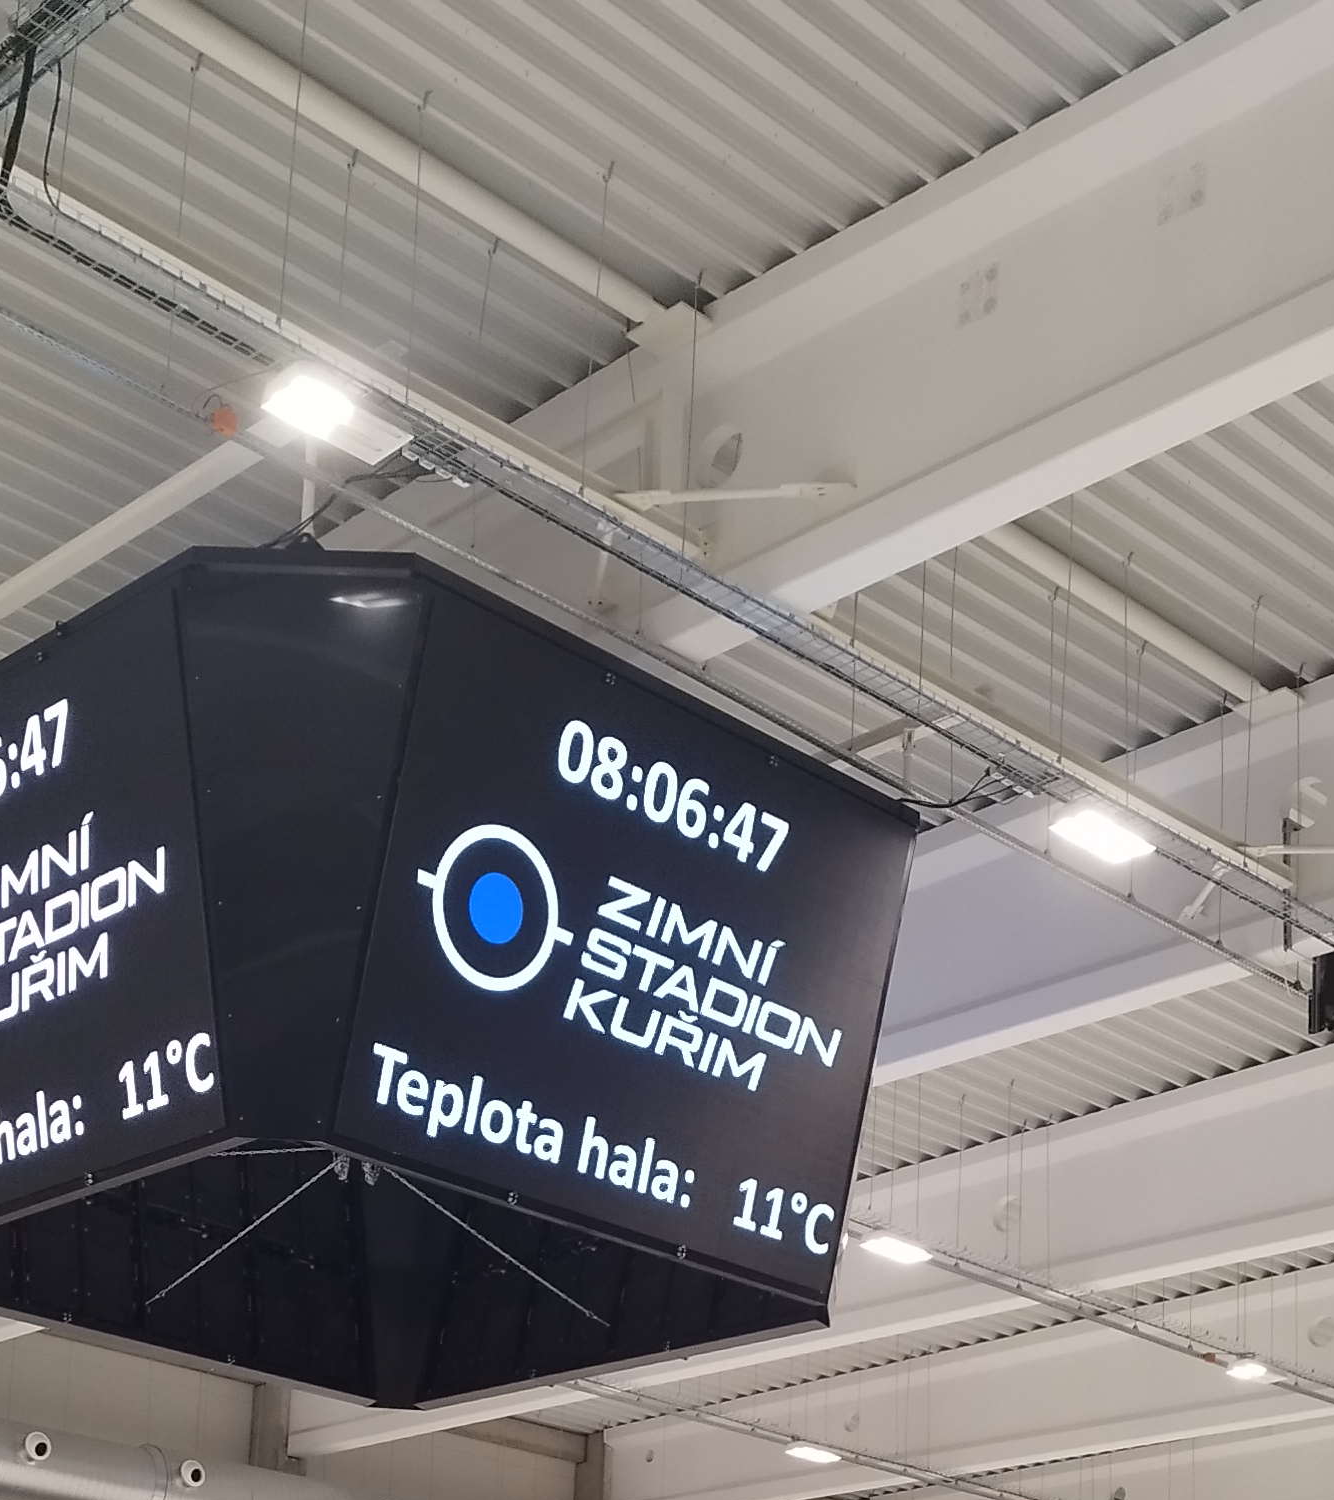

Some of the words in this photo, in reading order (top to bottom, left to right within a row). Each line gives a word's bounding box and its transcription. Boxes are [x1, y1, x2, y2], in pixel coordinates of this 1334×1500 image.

[557, 719, 789, 872] 08:06:47
[597, 875, 786, 987] ZIMNÍ
[563, 978, 767, 1092] KUŘIM
[580, 927, 842, 1067] STADION
[118, 1032, 215, 1120] 11°C
[373, 1042, 564, 1165] Teplota
[578, 1116, 695, 1209] hala:
[732, 1178, 836, 1255] 11°C
